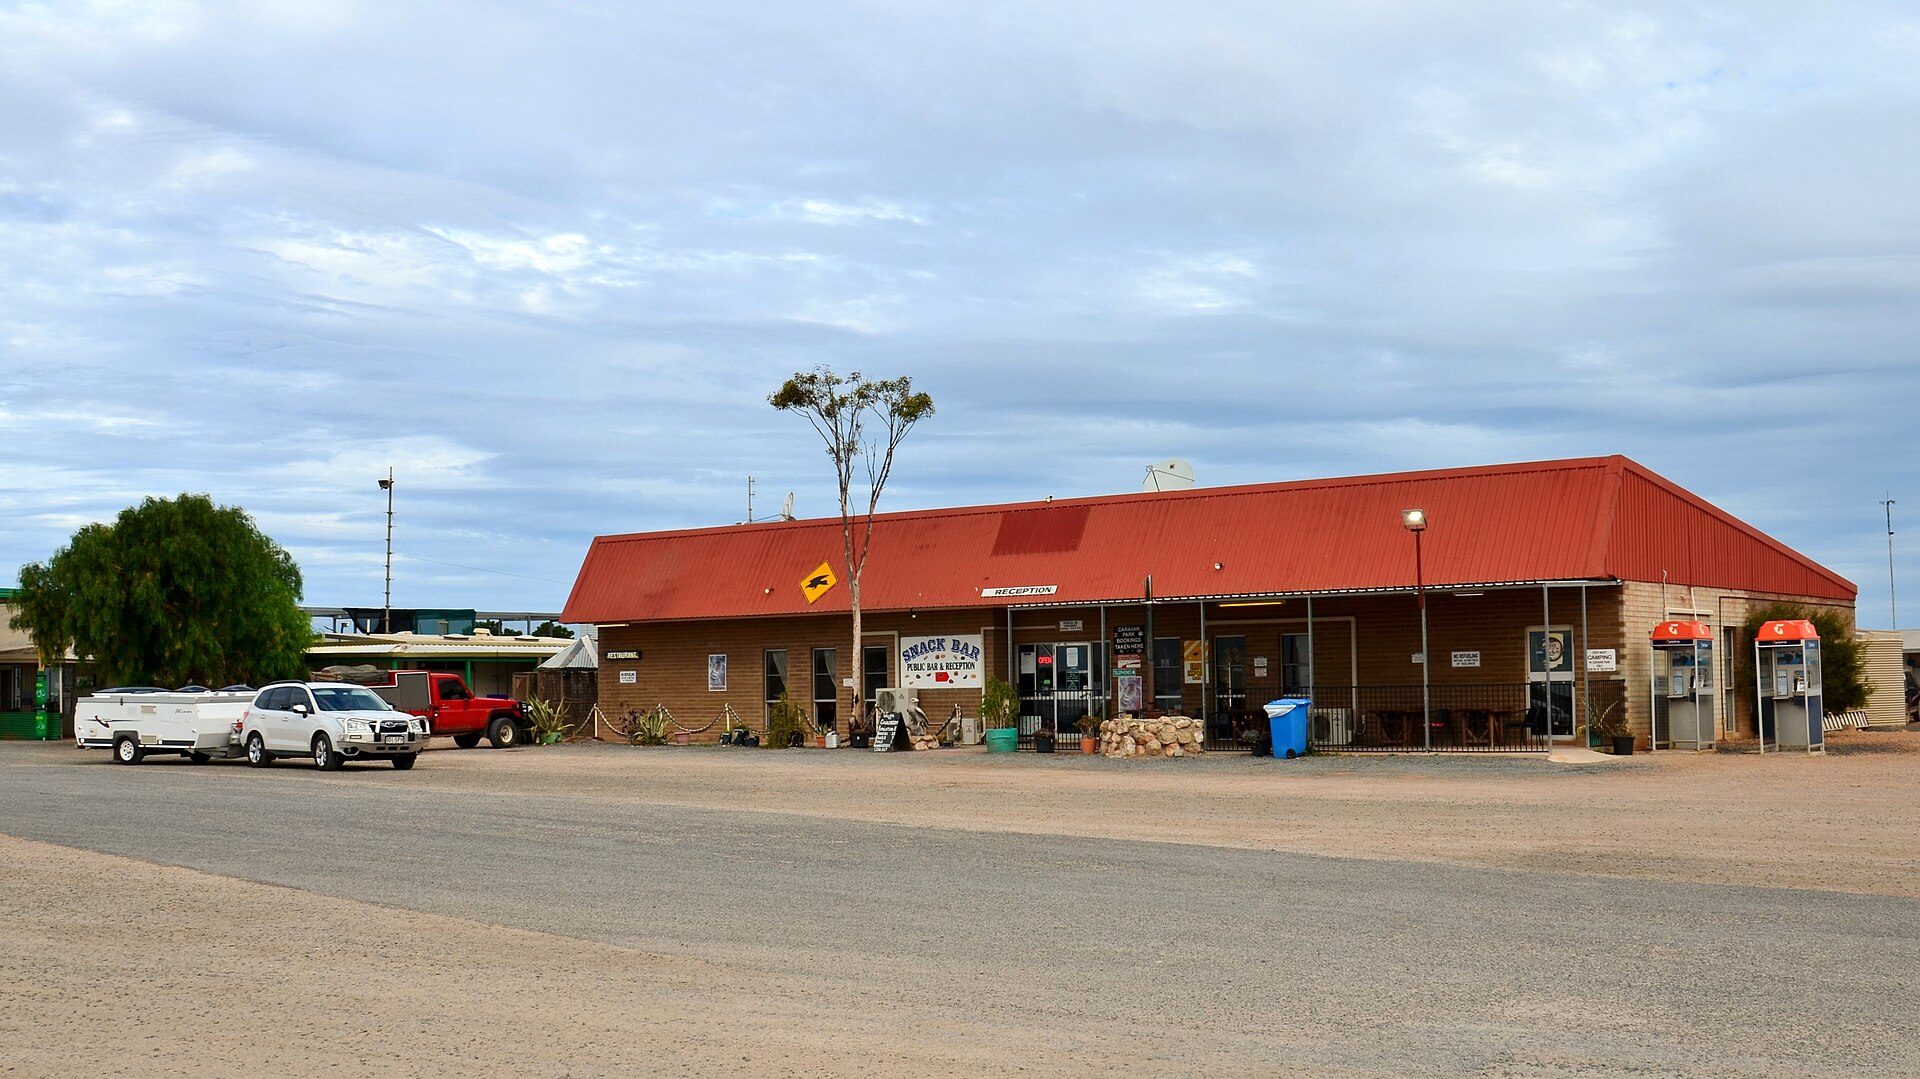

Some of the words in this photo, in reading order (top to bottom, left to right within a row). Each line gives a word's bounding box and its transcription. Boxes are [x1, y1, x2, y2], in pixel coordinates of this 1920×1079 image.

[995, 587, 1053, 595] RECEPTION
[902, 638, 946, 663] SNACK
[951, 639, 980, 661] BAR
[1038, 656, 1053, 664] OPEN
[907, 663, 925, 671] PUBLIC
[927, 663, 938, 671] BAR
[946, 662, 976, 670] RECEPTION
